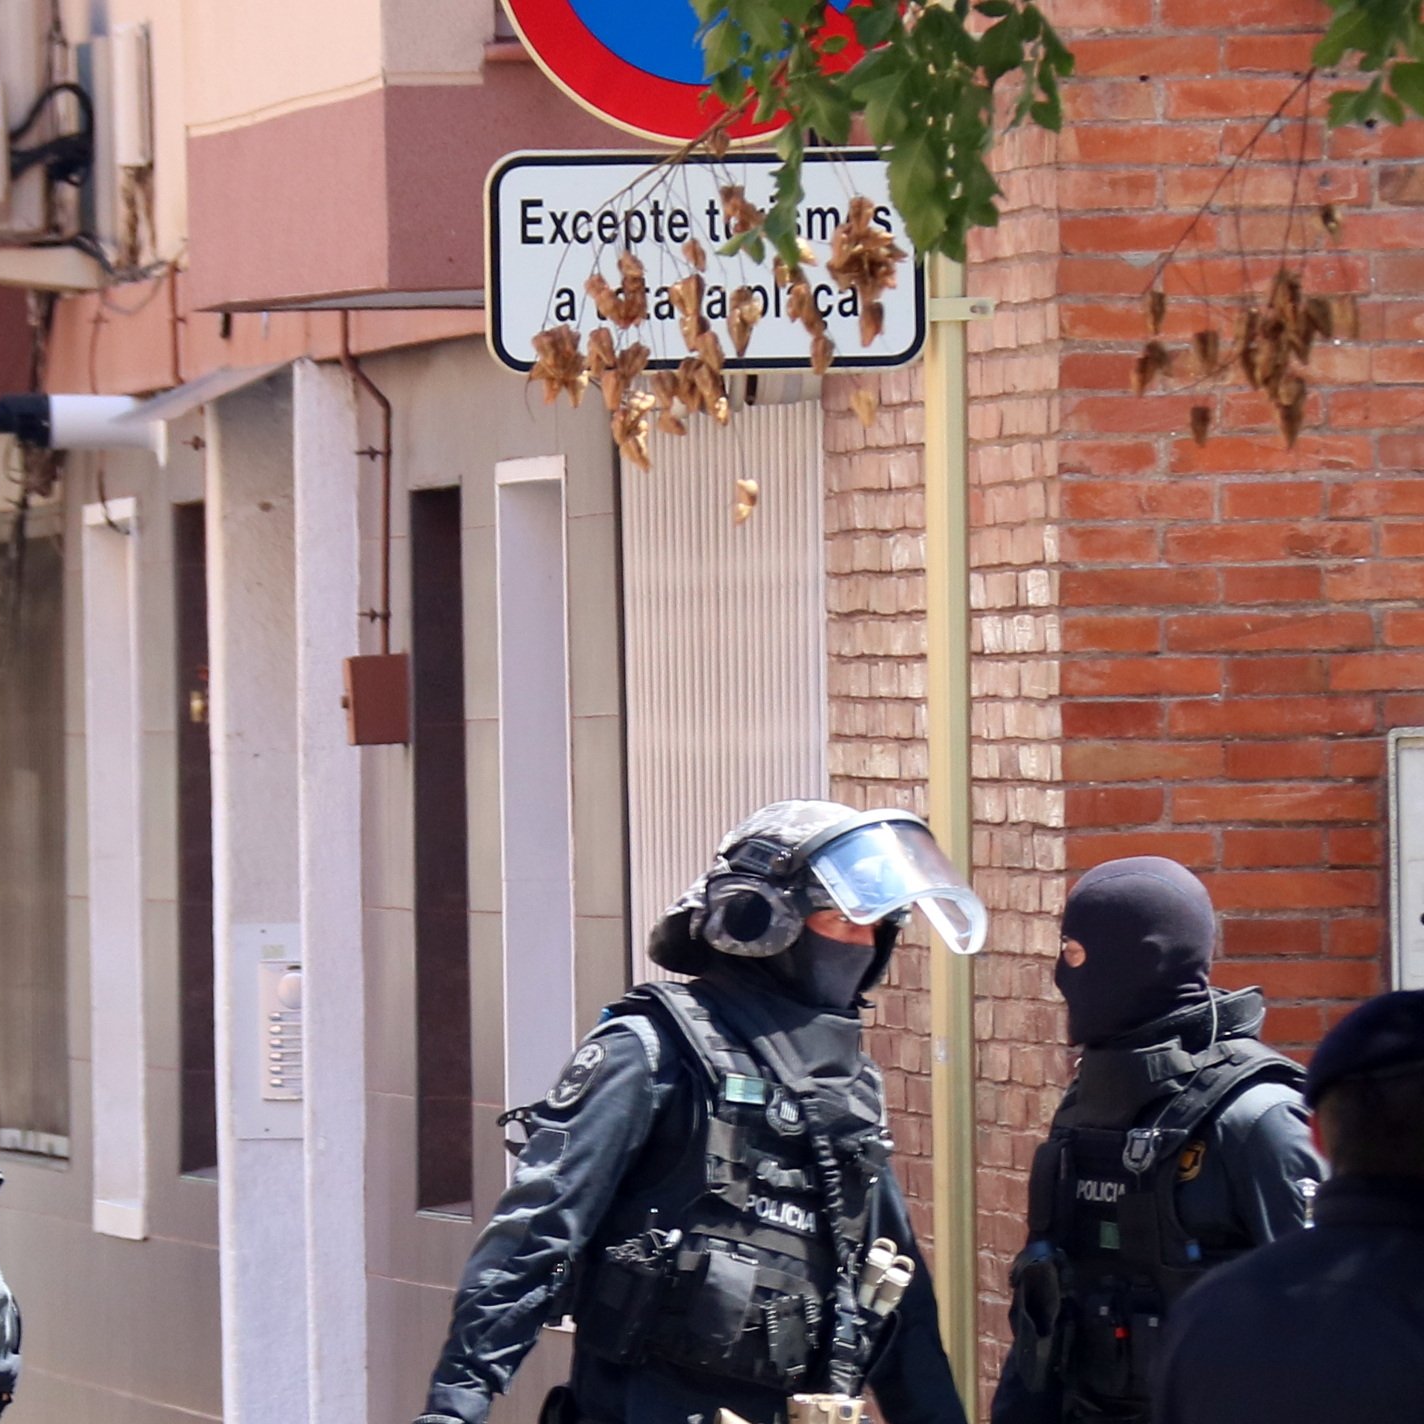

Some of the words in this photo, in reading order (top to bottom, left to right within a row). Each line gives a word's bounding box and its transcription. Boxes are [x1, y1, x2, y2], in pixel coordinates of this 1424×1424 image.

[520, 199, 691, 252] Excepte
[554, 287, 576, 321] a
[1076, 1180, 1126, 1202] POLICIA
[742, 1194, 817, 1233] POLICIA
